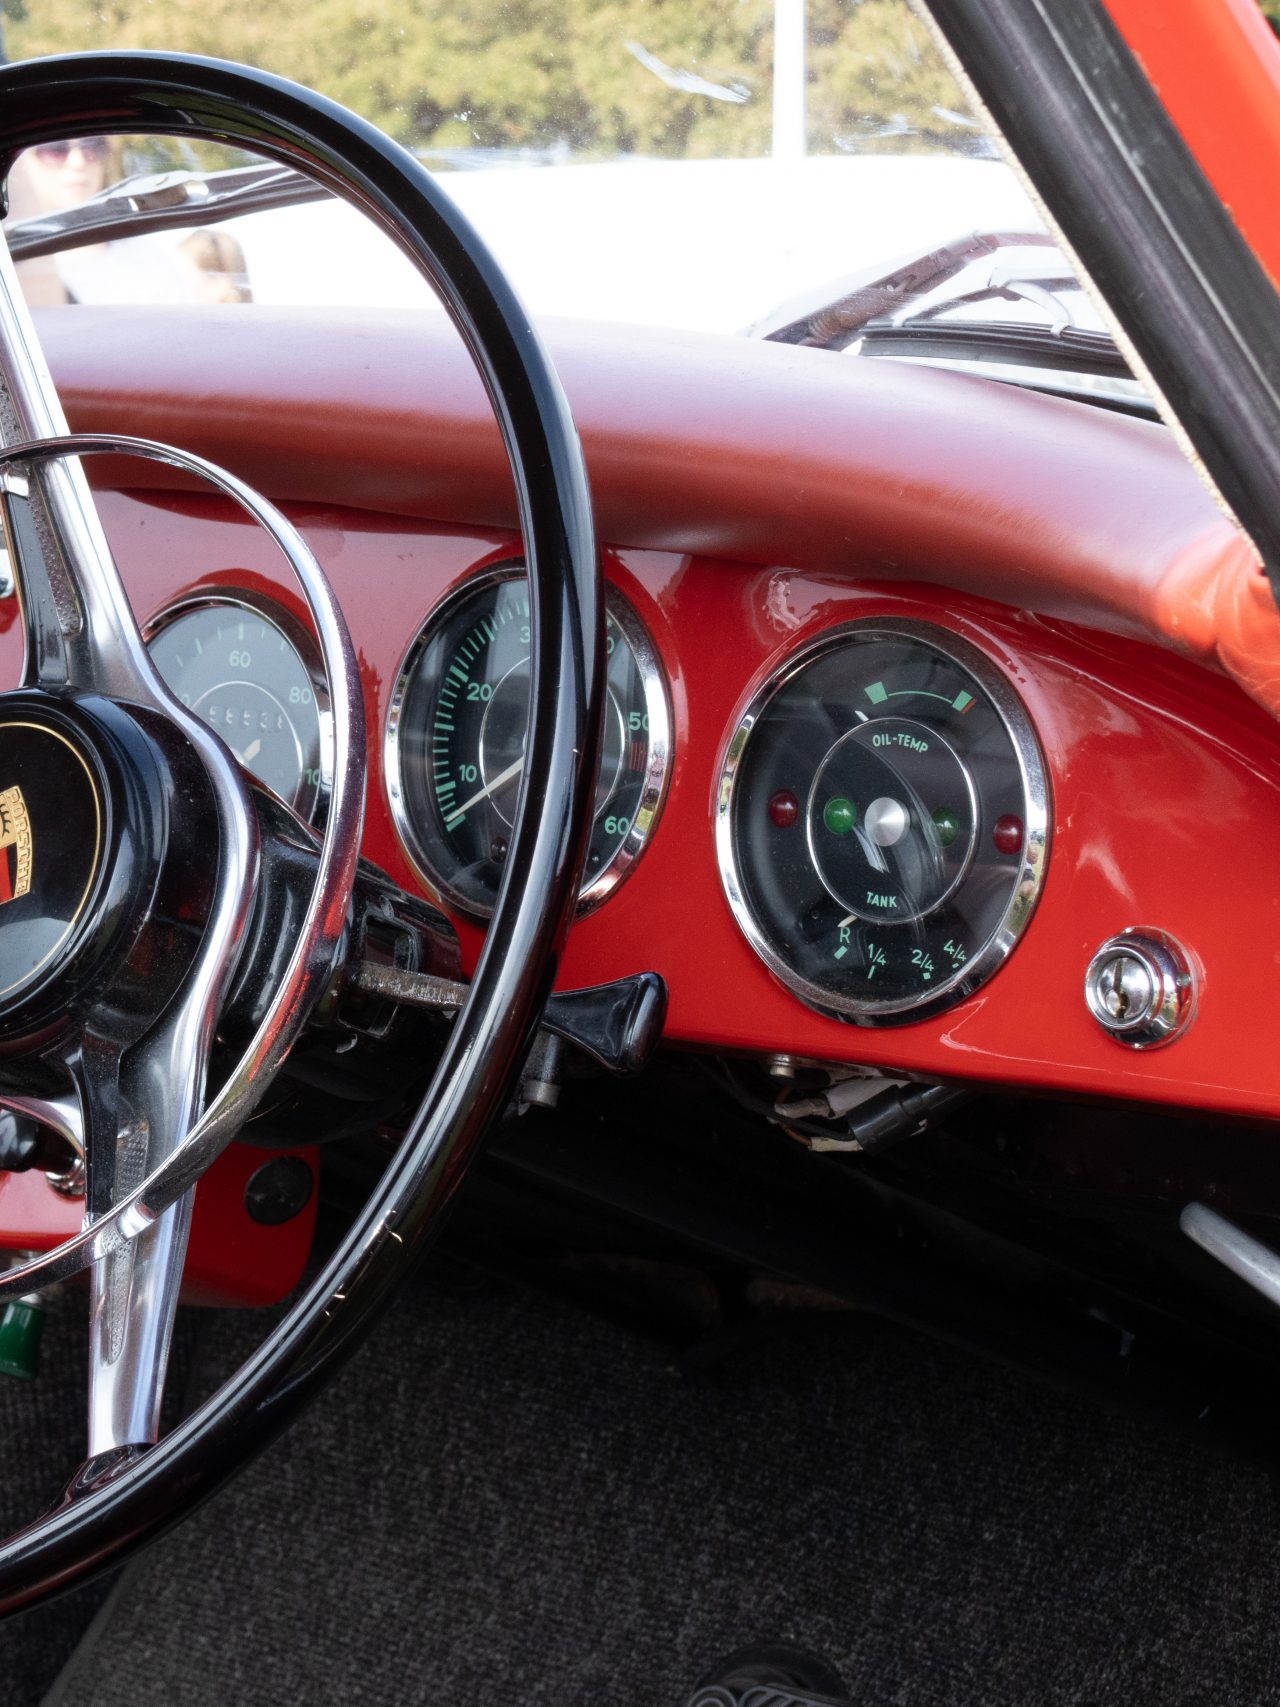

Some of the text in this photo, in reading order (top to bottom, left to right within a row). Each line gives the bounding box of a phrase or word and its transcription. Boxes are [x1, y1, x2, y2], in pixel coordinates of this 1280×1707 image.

[229, 651, 251, 668] 60
[289, 686, 313, 705] 80
[467, 683, 493, 701] 20
[629, 711, 650, 730] 50
[872, 733, 929, 753] OIL-TEMP
[459, 764, 477, 782] 10
[605, 816, 629, 835] 60
[5, 787, 30, 896] PORSCHE
[866, 891, 898, 908] TANK
[840, 926, 851, 944] R
[868, 943, 887, 966] 1/4
[943, 939, 967, 962] 4/4
[911, 949, 935, 972] 2/4
